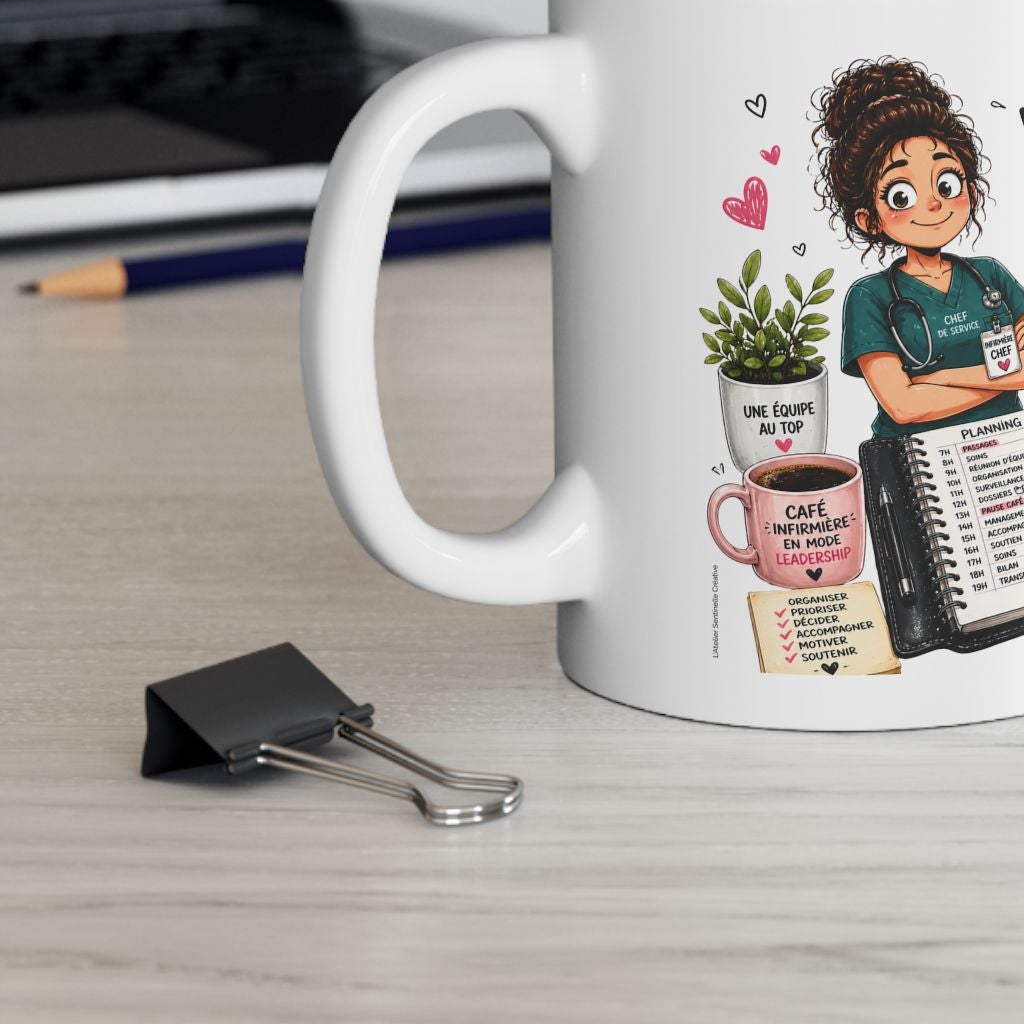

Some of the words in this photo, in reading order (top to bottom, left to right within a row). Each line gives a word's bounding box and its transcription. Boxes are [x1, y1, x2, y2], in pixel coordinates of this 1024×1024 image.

[944, 311, 968, 324] CHEF
[938, 329, 949, 338] DE
[951, 320, 980, 335] SERVICE
[991, 346, 1012, 360] CHEF
[744, 405, 768, 418] UNE
[773, 402, 815, 417] ÉQUIPE
[759, 422, 778, 435] AU
[780, 420, 804, 434] TOP
[962, 439, 998, 452] PASSAGES
[966, 453, 988, 462] SOINS
[969, 460, 1001, 472] RÉUNION
[947, 479, 961, 487] 10H
[972, 465, 1023, 482] ORGANISATION
[950, 489, 964, 497] 11H
[975, 476, 1024, 493] SURVEILLANCE
[952, 500, 967, 508] 12H
[978, 489, 1012, 503] DOSSIERS
[786, 499, 828, 520] CAFÉ
[955, 511, 970, 519] 13H
[981, 502, 1005, 515] PAUSE
[1006, 498, 1024, 510] CAFÉ
[772, 516, 850, 535] INFIRMIÈRE
[958, 522, 973, 531] 14H
[784, 538, 800, 549] EN
[806, 536, 842, 548] MODE
[961, 534, 976, 542] 15H
[964, 546, 979, 554] 16H
[991, 536, 1022, 549] SOUTIEN
[776, 547, 851, 565] LEADERSHIP
[967, 558, 982, 566] 17H
[994, 550, 1017, 561] SOINS
[970, 570, 984, 579] 18H
[997, 561, 1019, 573] BILAN
[972, 582, 988, 591] 19H
[788, 593, 848, 606] ORGANISER
[791, 604, 847, 616] PRIORISER
[794, 615, 840, 627] DÉCIDER
[796, 621, 874, 638] ACCOMPAGNER
[799, 636, 848, 650] MOTIVER
[802, 647, 857, 662] SOUTENIR
